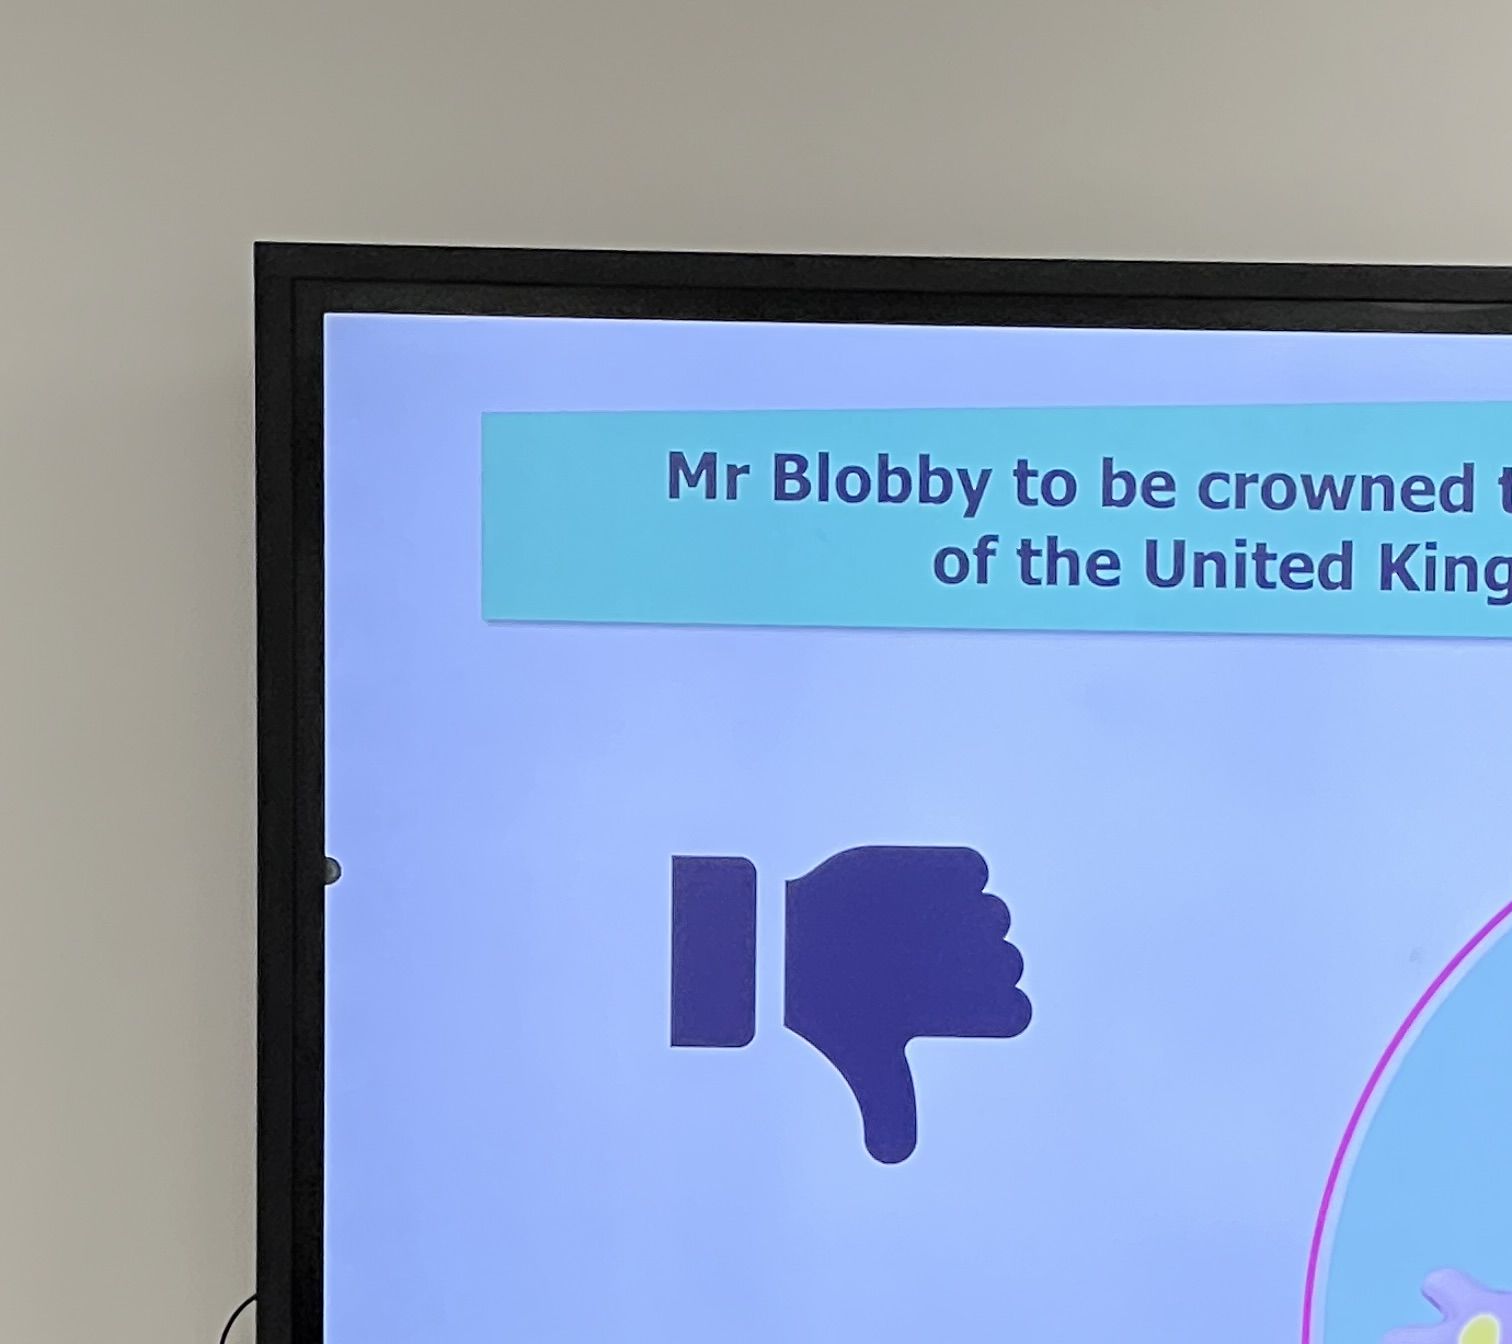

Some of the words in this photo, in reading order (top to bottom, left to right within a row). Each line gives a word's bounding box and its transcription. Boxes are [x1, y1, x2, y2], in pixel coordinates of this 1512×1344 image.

[669, 451, 751, 501] Mr
[773, 451, 993, 519] Blobby
[1012, 458, 1077, 508] to
[1101, 456, 1177, 509] be
[1198, 462, 1475, 514] crowned
[933, 534, 1000, 585] of
[1015, 535, 1121, 588] the
[1145, 538, 1354, 591] United
